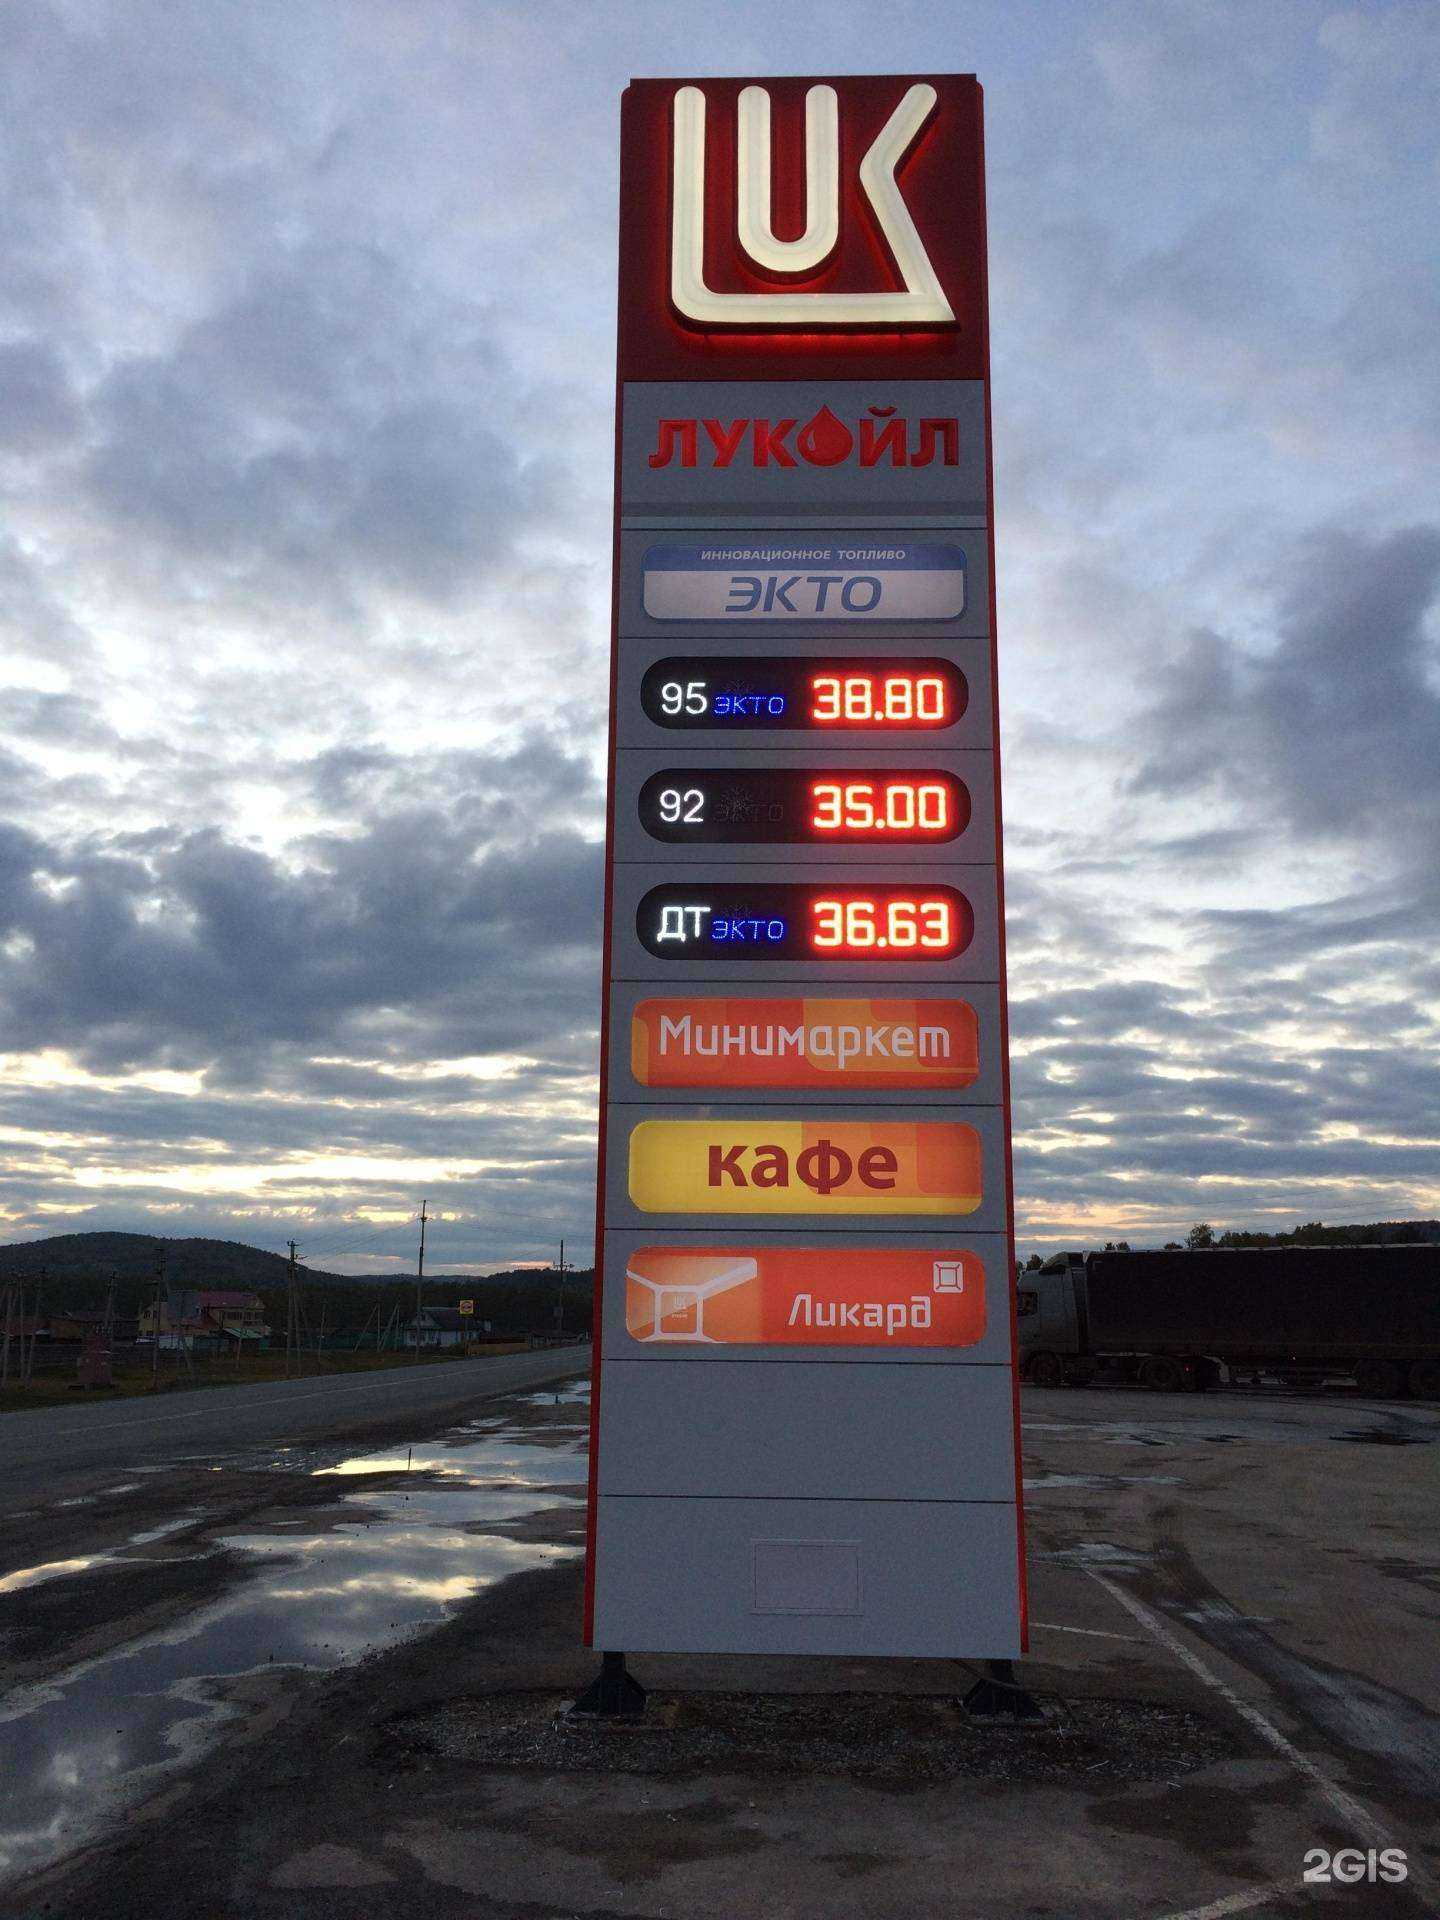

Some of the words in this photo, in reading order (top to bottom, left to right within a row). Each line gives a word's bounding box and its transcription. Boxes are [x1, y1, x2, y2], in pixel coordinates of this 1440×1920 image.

[648, 404, 960, 468] ЛУКОЙЛ
[700, 549, 831, 562] ИННОВАЦИОННОЕ
[838, 549, 907, 561] ТОПЛИВО
[725, 576, 883, 612] ЭКТО
[661, 682, 708, 715] 95
[713, 696, 785, 715] ЭКТО
[812, 678, 945, 721] 38.80
[659, 789, 705, 823] 92
[812, 785, 948, 830] 35.00
[656, 906, 711, 942] ДТ
[711, 920, 785, 941] ЭКТО
[813, 902, 951, 948] 36.63
[659, 1015, 950, 1069] Минимаркет
[707, 1139, 898, 1195] кафе
[788, 1294, 932, 1336] Ликард
